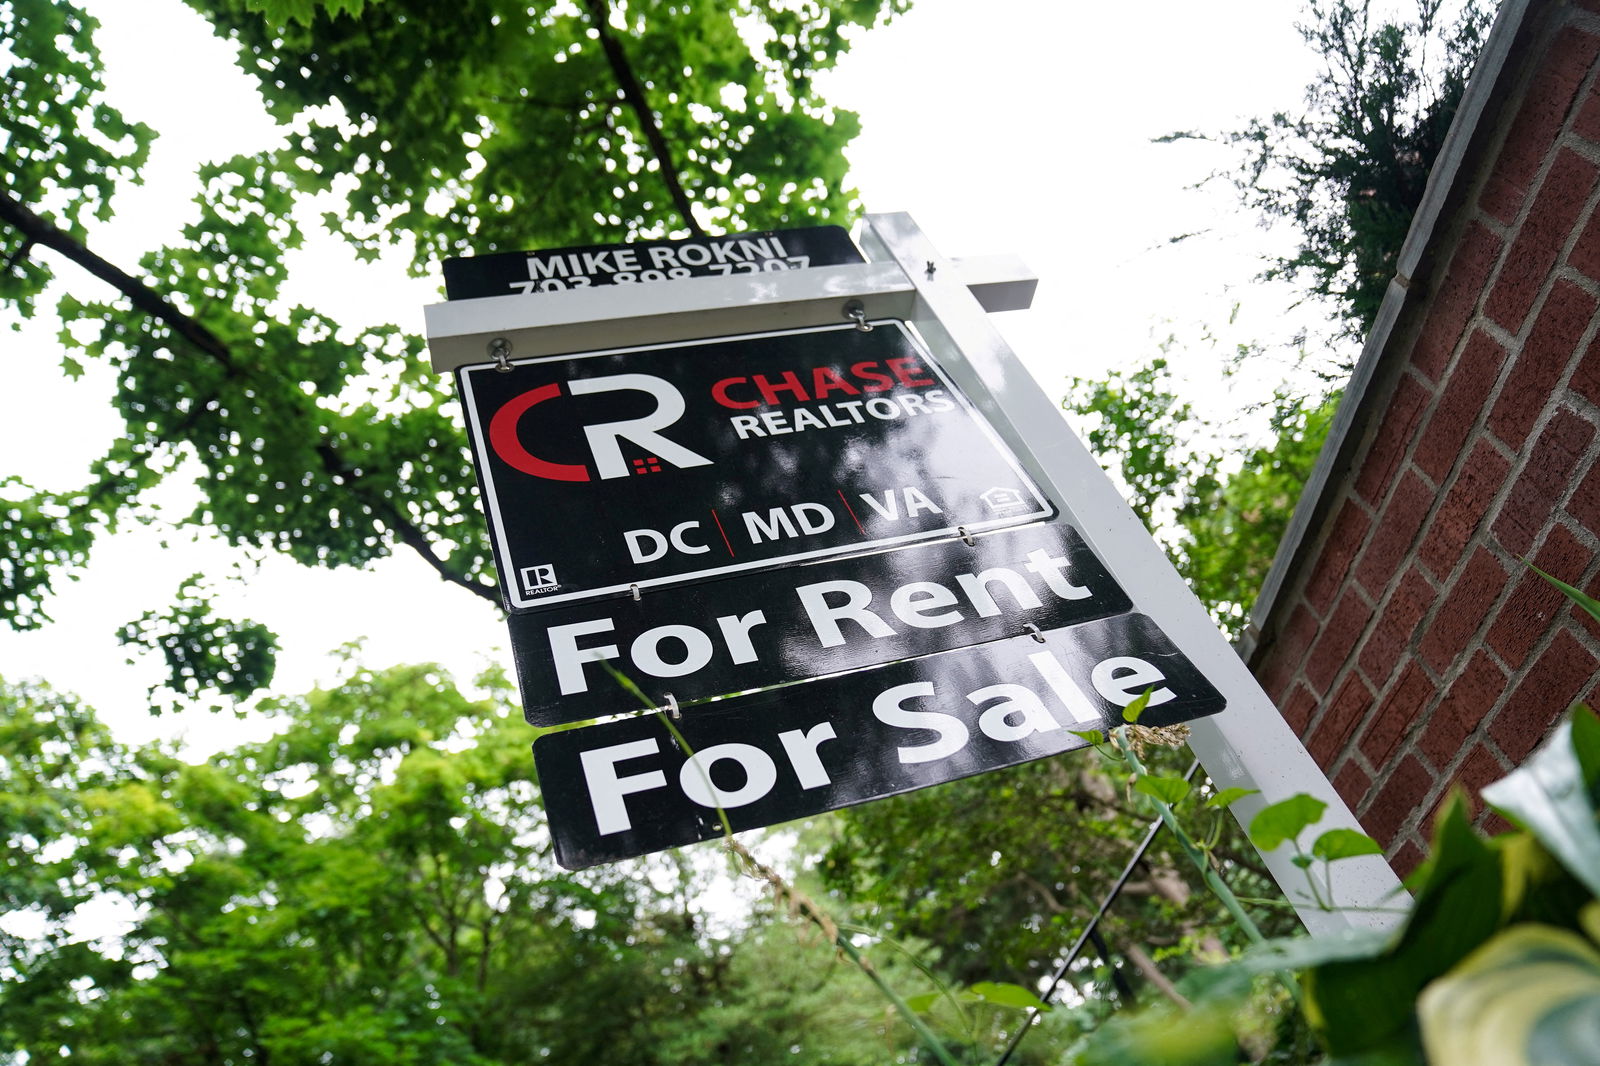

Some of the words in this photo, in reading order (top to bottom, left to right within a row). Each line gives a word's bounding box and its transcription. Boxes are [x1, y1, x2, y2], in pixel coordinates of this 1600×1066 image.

[527, 249, 642, 280] MIKE
[647, 236, 788, 268] ROKNI
[711, 356, 935, 409] CHASE
[730, 389, 955, 440] REALTORS
[623, 520, 711, 564] DC
[741, 502, 836, 544] MD
[858, 486, 943, 521] VA
[546, 609, 767, 696] For
[795, 548, 1093, 649] Rent
[579, 720, 837, 836] For
[872, 650, 1177, 765] Sale
